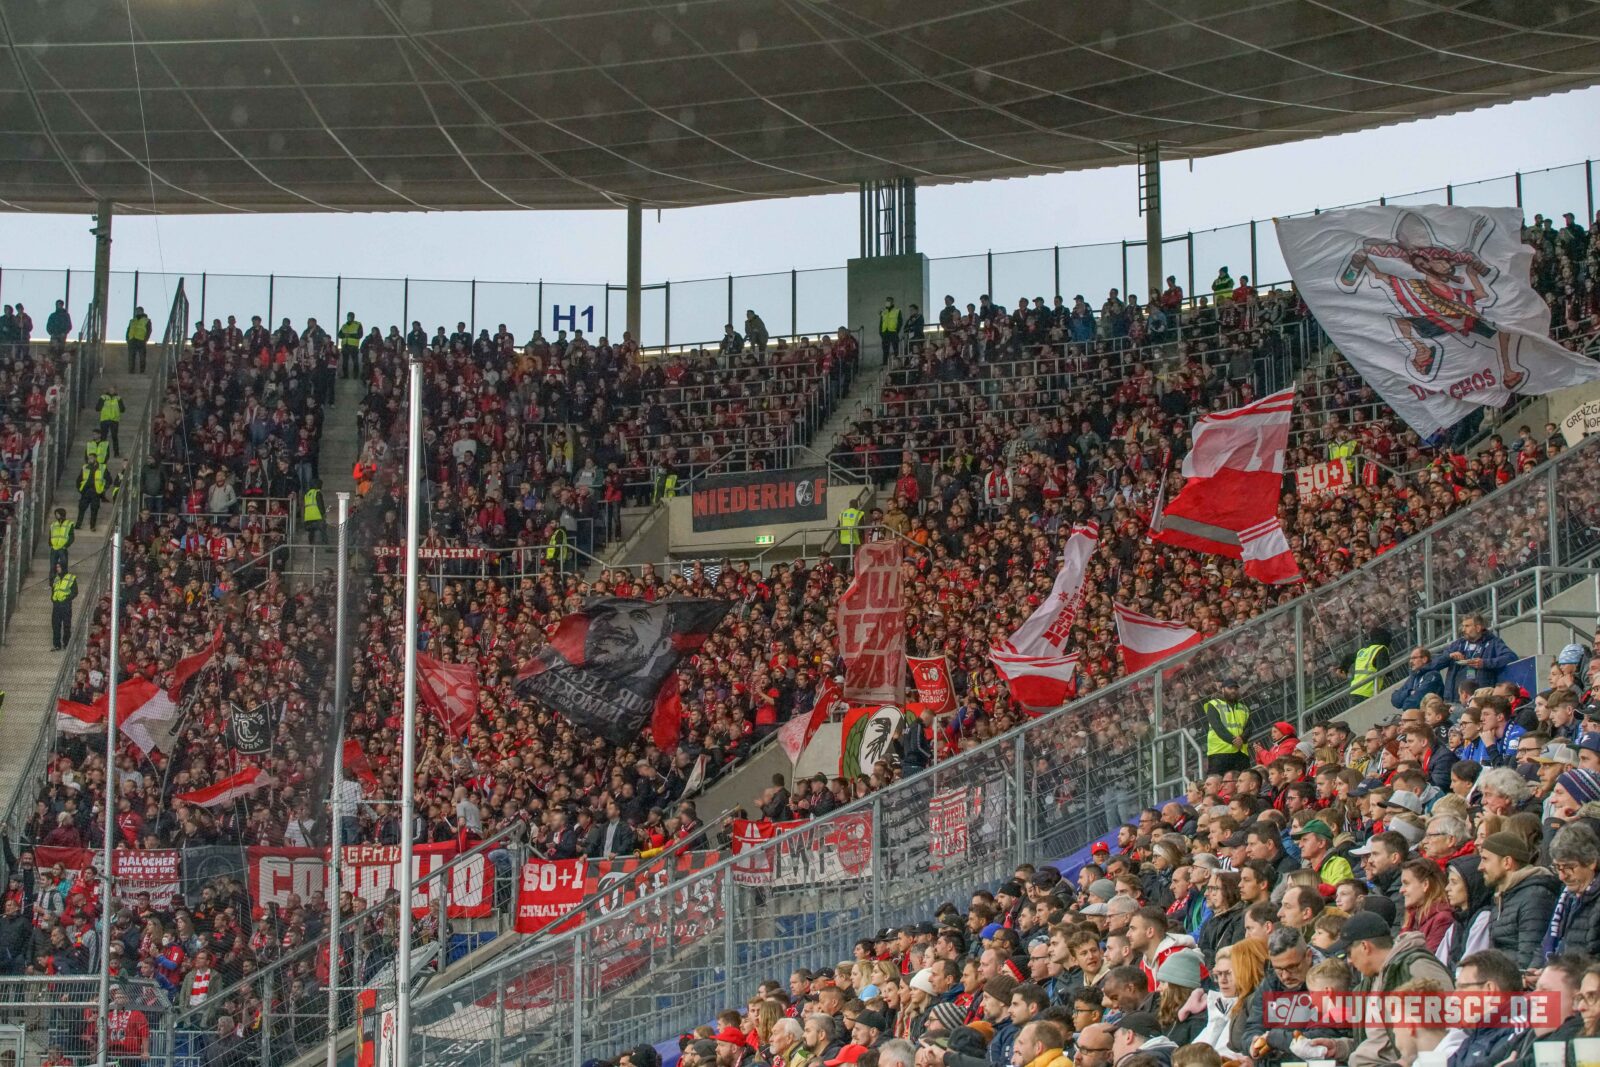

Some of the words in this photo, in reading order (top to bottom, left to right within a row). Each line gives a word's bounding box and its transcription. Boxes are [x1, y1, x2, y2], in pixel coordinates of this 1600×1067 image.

[553, 305, 594, 332] H1
[417, 548, 483, 559] RHALTEN!
[118, 856, 176, 867] MALOCHER
[118, 866, 143, 874] IMMER
